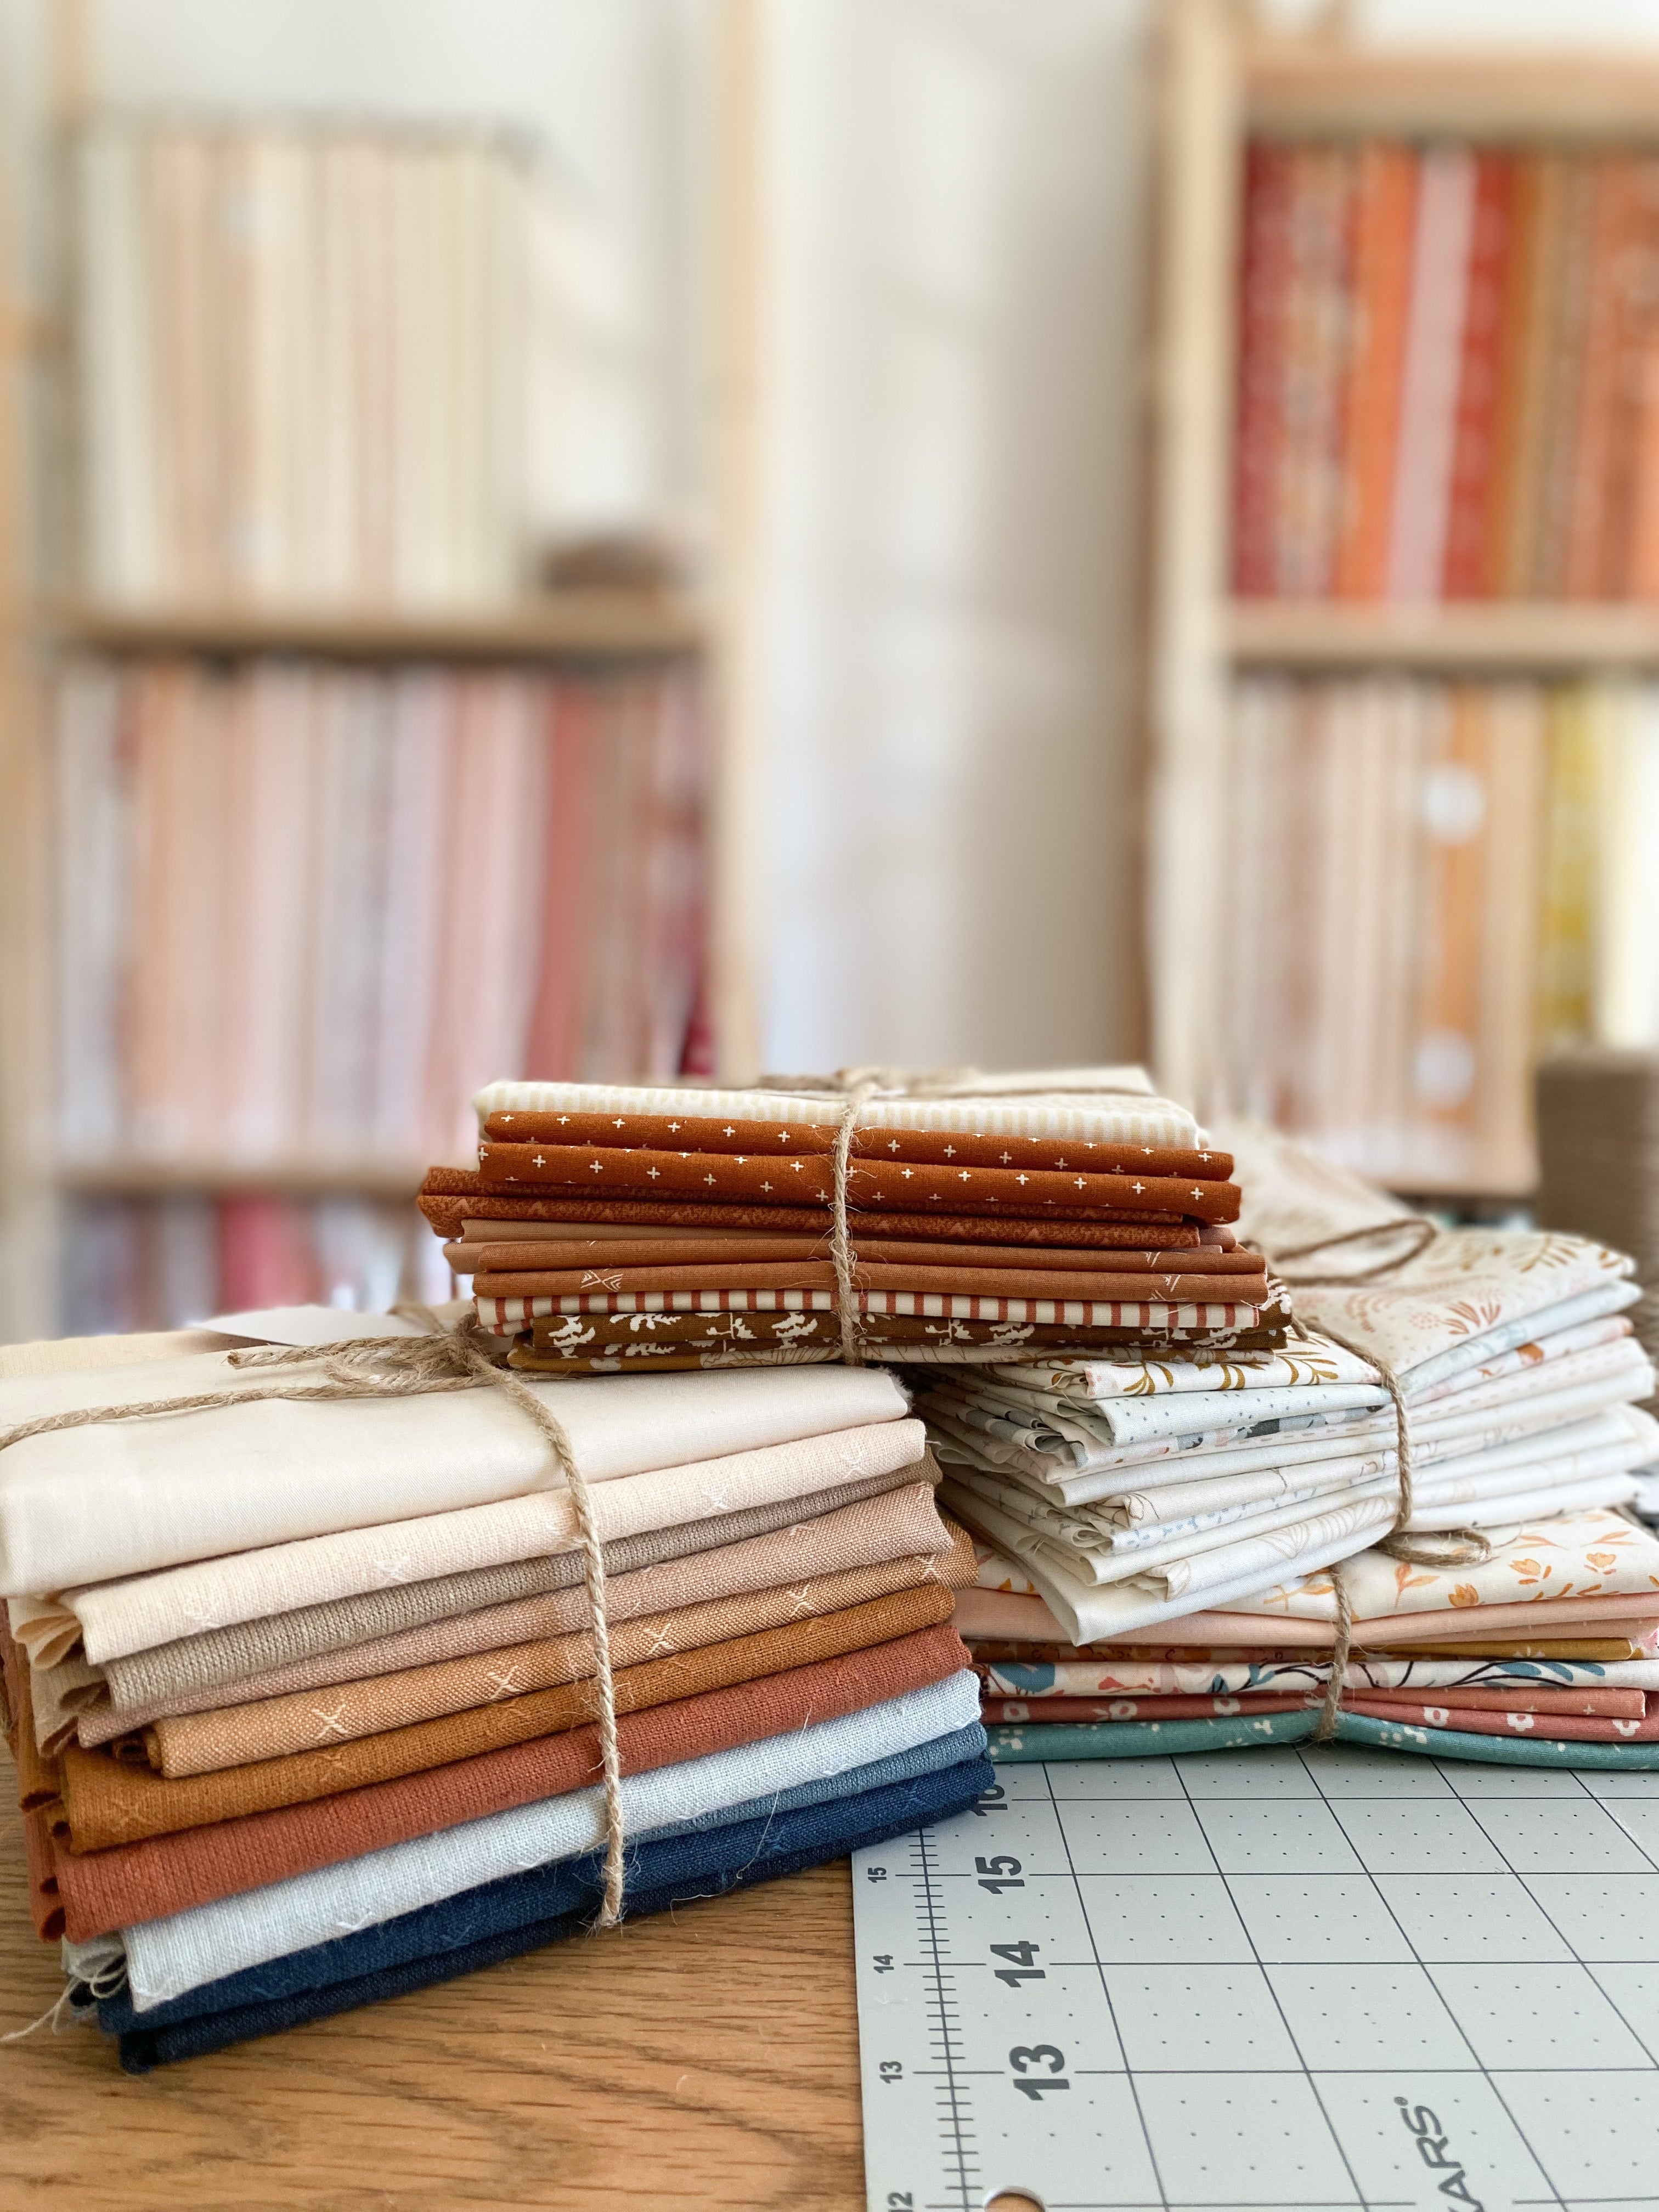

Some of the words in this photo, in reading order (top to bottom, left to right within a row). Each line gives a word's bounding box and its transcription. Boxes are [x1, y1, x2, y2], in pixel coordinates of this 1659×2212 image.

[867, 1867, 887, 1883] 15
[974, 1855, 1025, 1894] 15
[873, 1954, 895, 1974] 14
[990, 1940, 1046, 1988] 14
[879, 2061, 903, 2084] 13
[1009, 2044, 1070, 2101] 13
[1400, 2105, 1484, 2212] ARS
